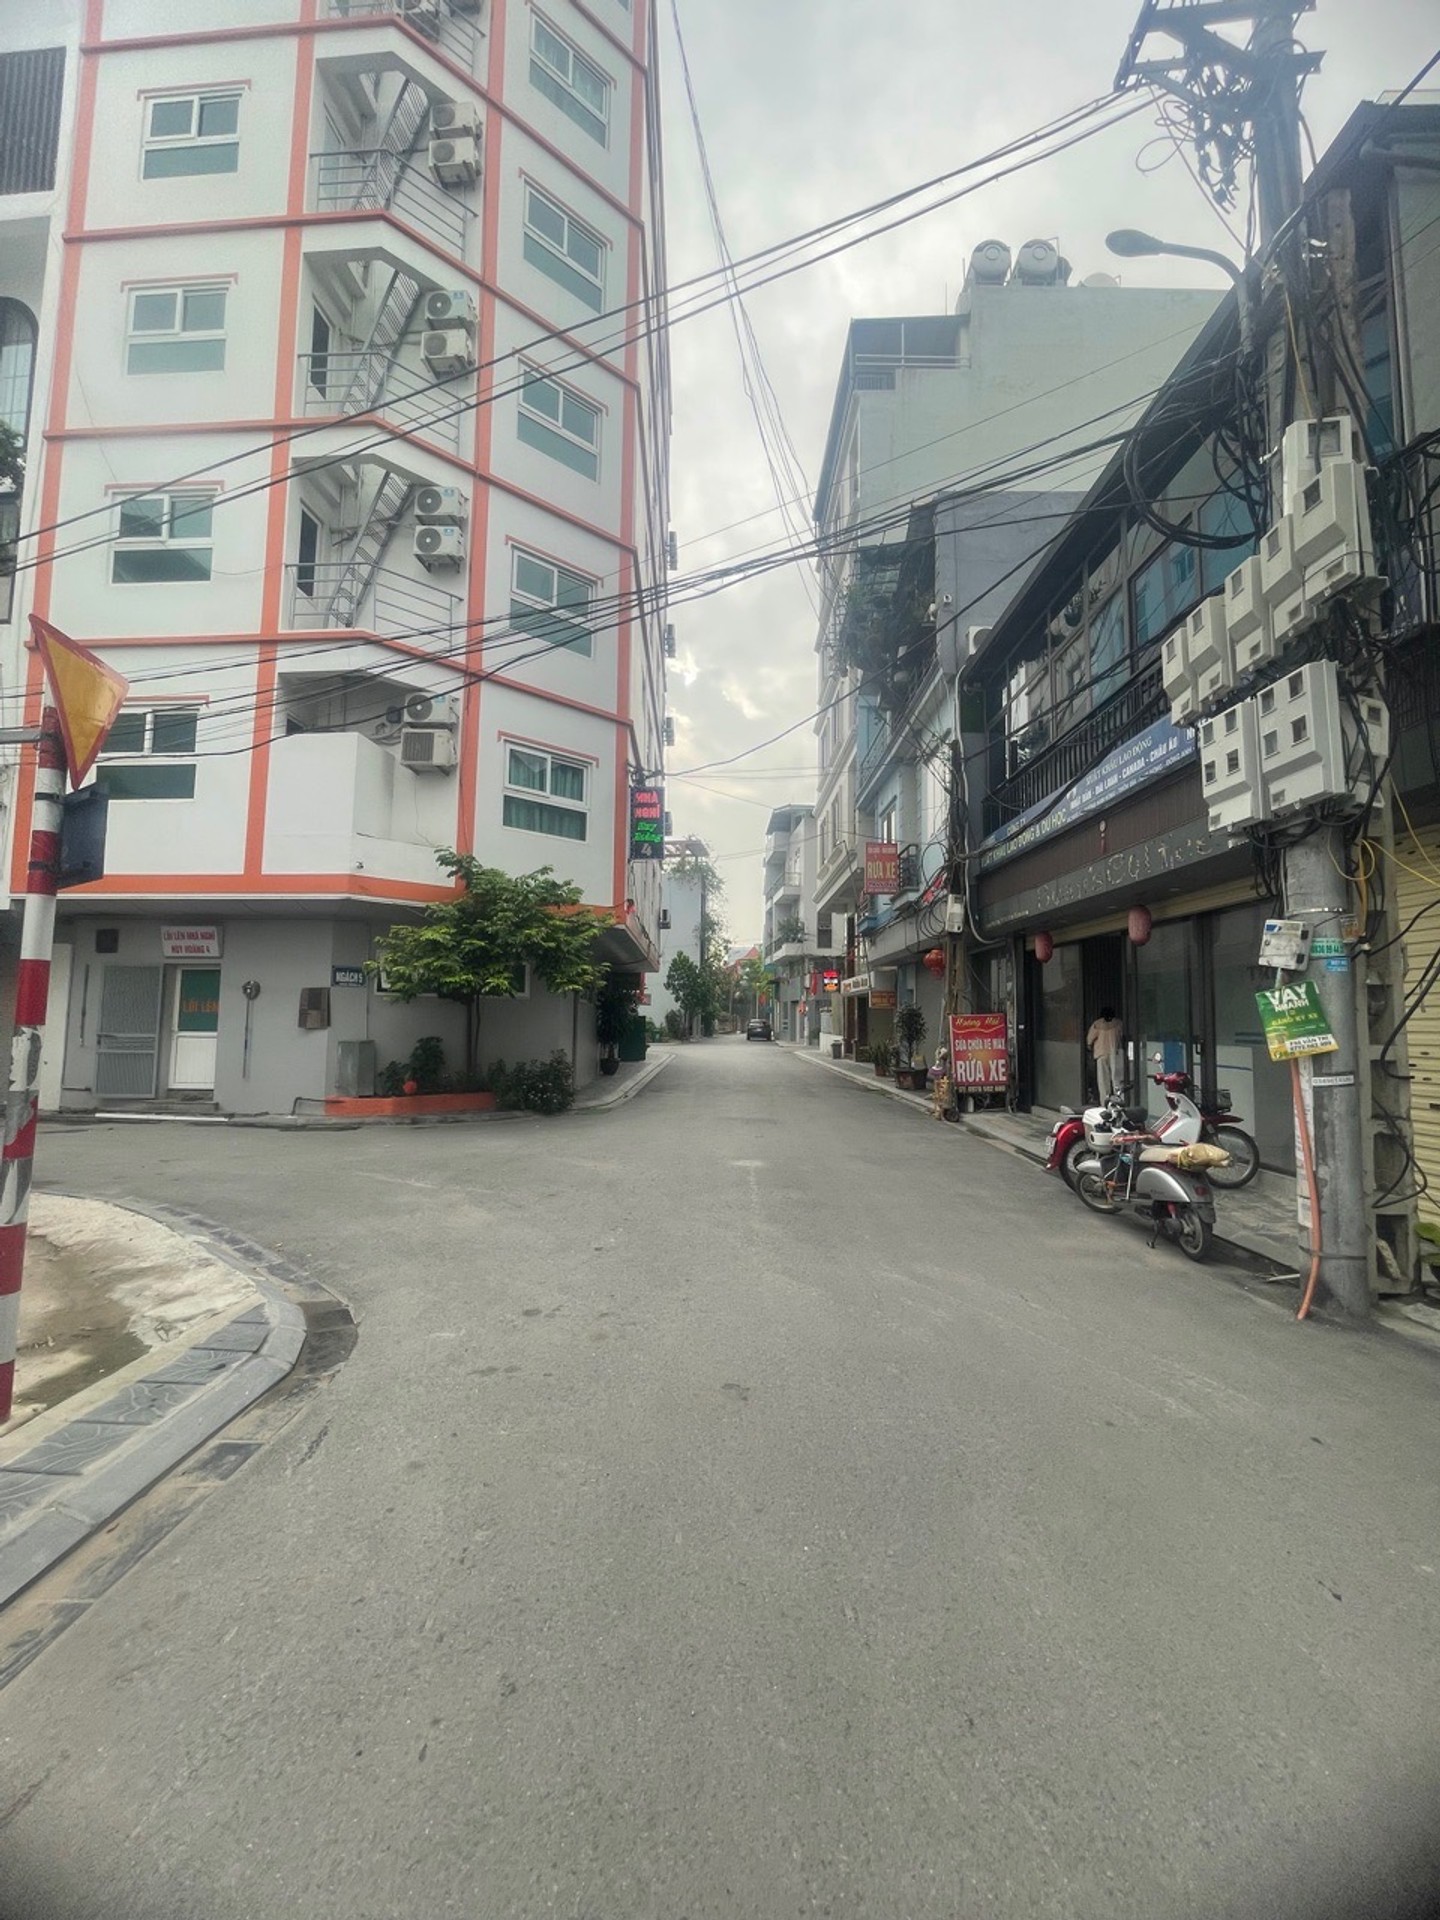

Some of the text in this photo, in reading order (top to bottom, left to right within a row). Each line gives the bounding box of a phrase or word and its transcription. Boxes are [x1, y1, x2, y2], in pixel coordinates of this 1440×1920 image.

[1122, 757, 1146, 779] CANADA
[641, 843, 653, 856] 4
[1265, 983, 1307, 1005] VAY
[956, 1052, 1007, 1082] RỬA XE
